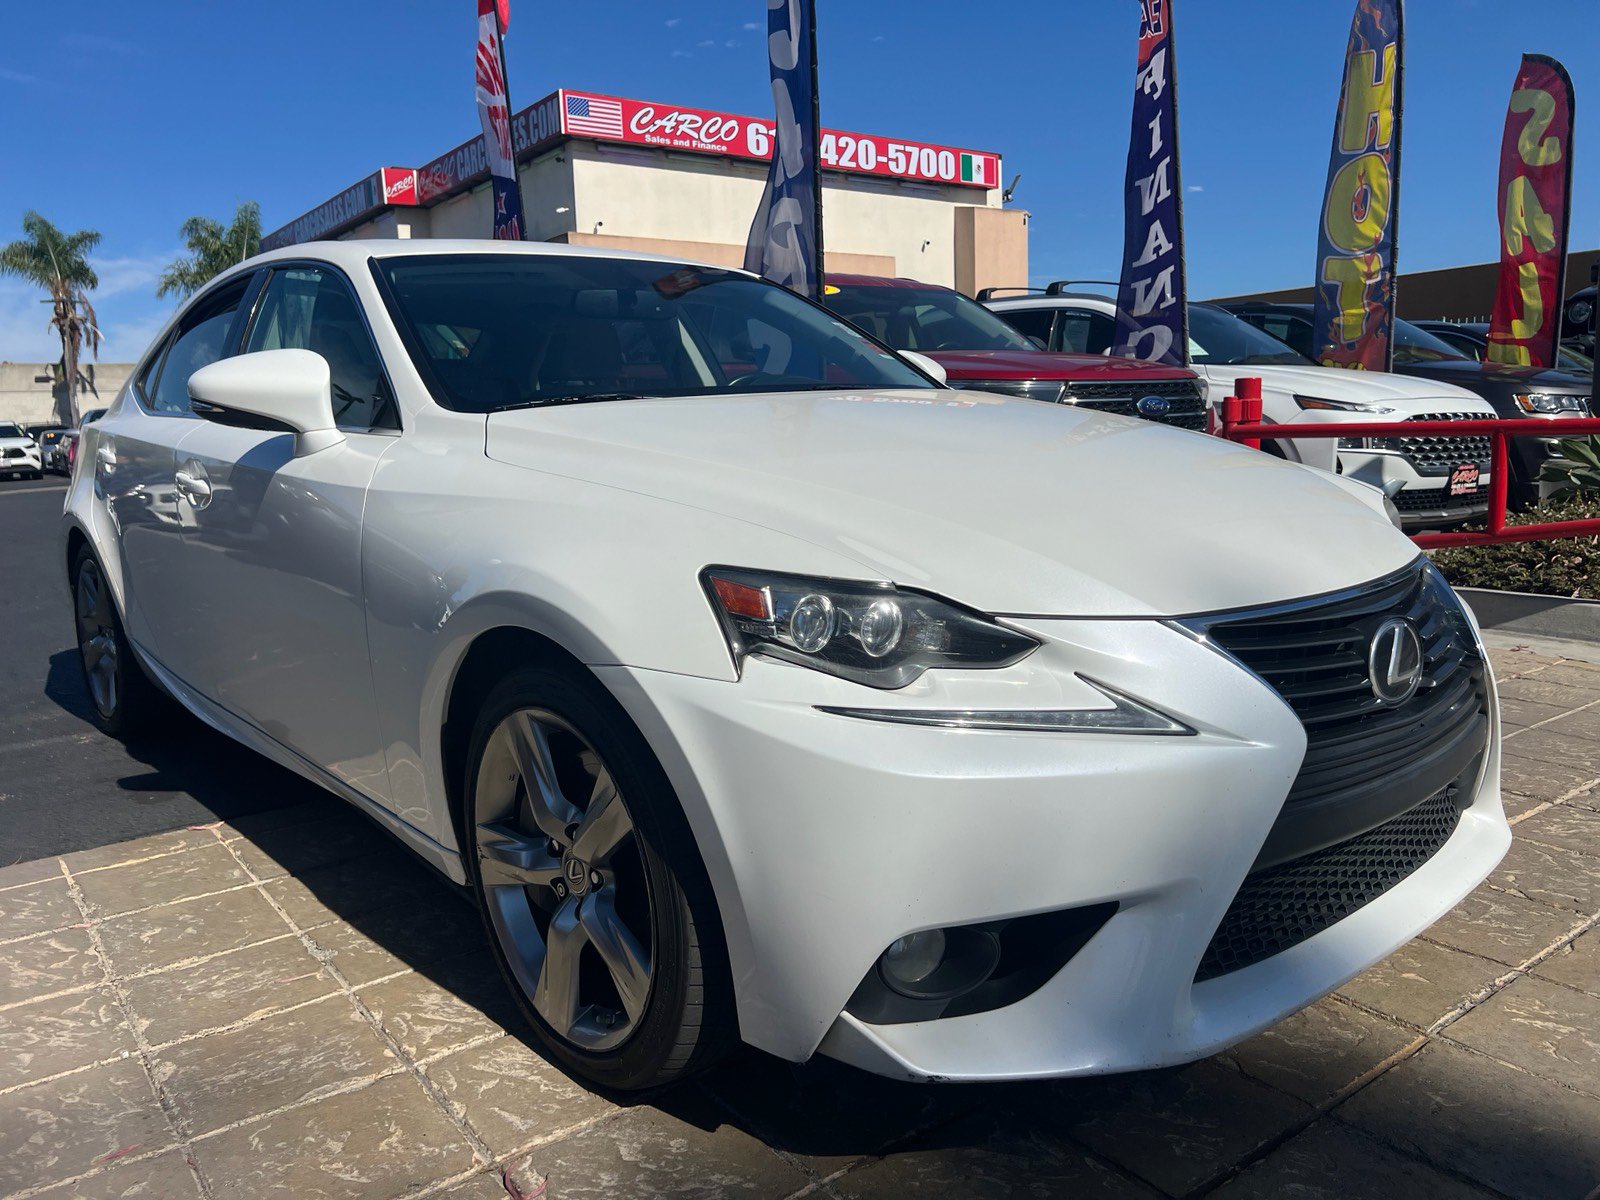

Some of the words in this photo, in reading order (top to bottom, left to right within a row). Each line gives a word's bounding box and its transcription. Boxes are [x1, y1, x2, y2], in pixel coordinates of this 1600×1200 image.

[630, 106, 739, 144] CARCO
[644, 134, 671, 145] Sales
[672, 137, 690, 148] and
[692, 141, 728, 152] Finance
[386, 174, 414, 197] CARCO
[1321, 41, 1396, 344] HOT
